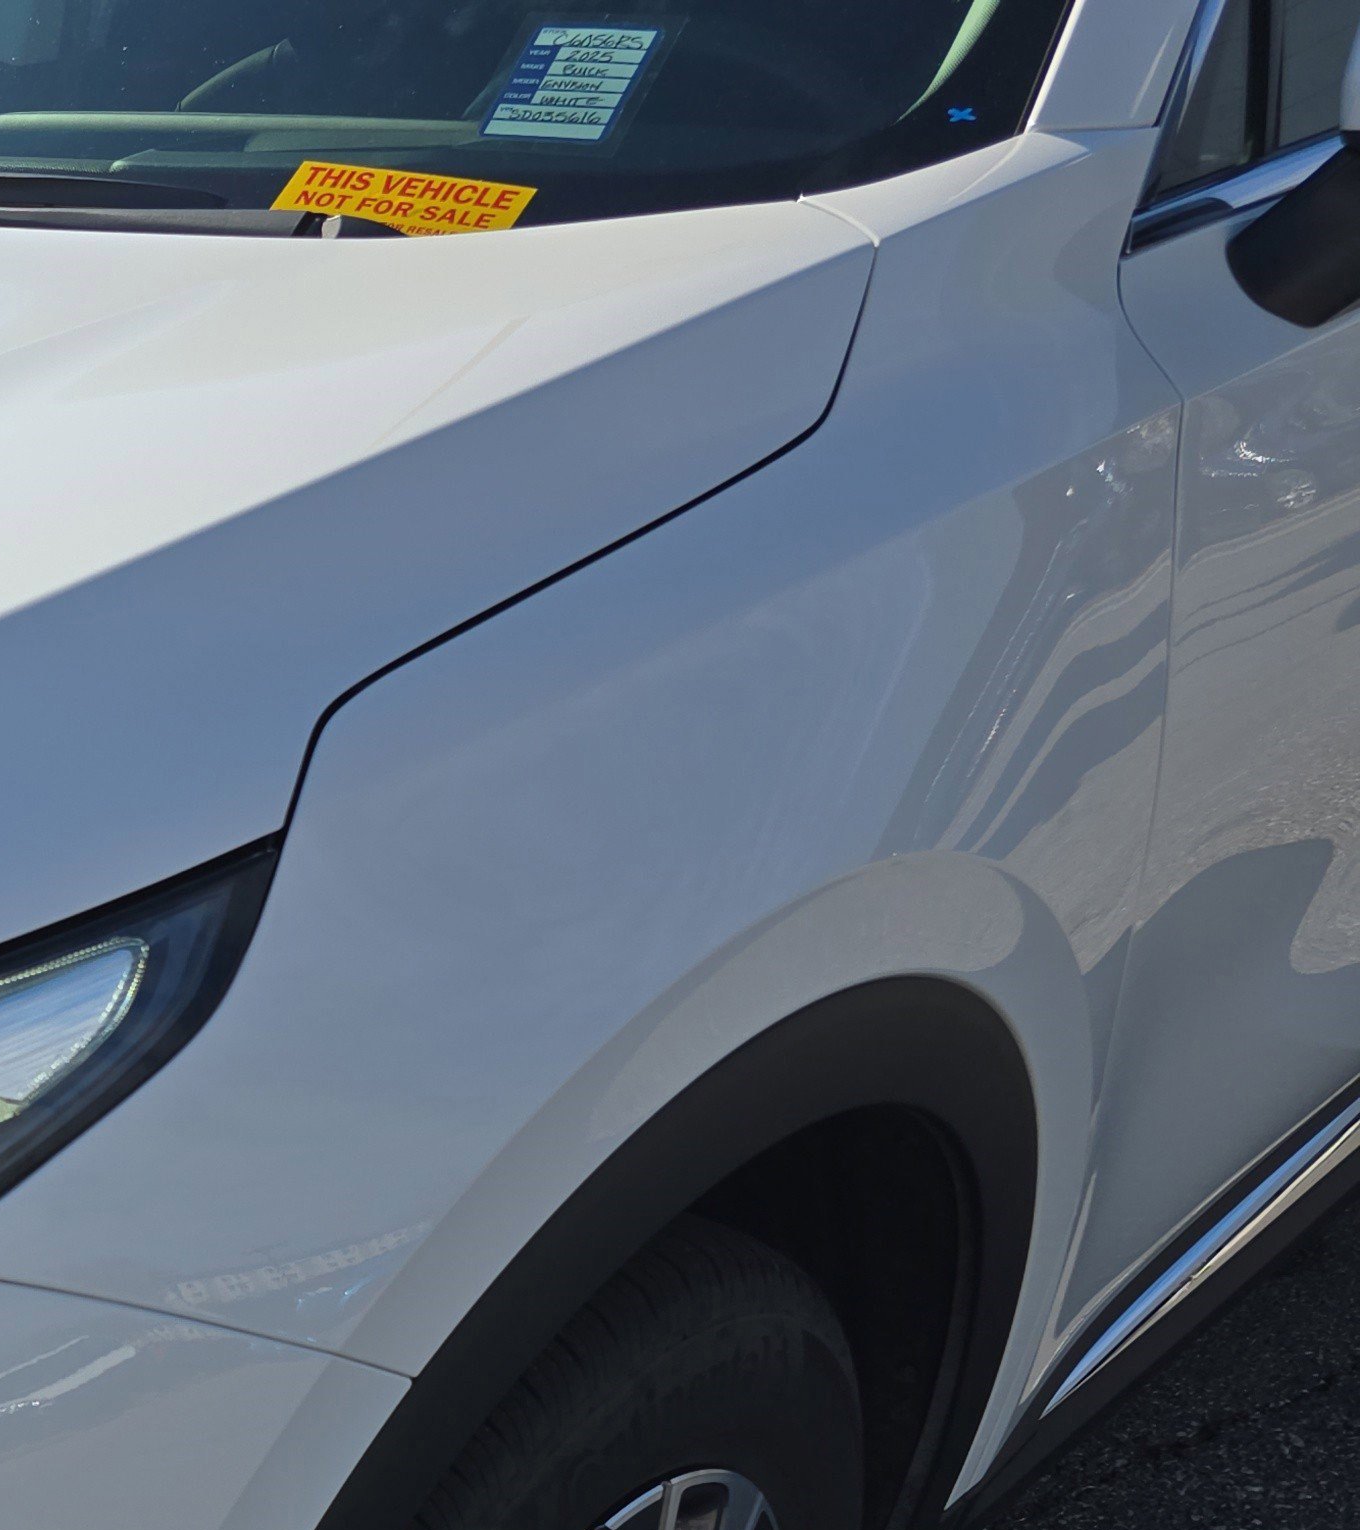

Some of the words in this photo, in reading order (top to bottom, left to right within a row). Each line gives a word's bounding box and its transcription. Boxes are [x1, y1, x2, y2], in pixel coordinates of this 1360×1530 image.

[564, 50, 615, 62] 2025
[563, 64, 609, 76] BUICK
[540, 96, 604, 106] WHITE
[303, 166, 375, 191] THIS
[382, 175, 521, 211] VEHICLE
[293, 190, 354, 210] NOT
[354, 197, 416, 217] FOR
[419, 206, 496, 229] SALE
